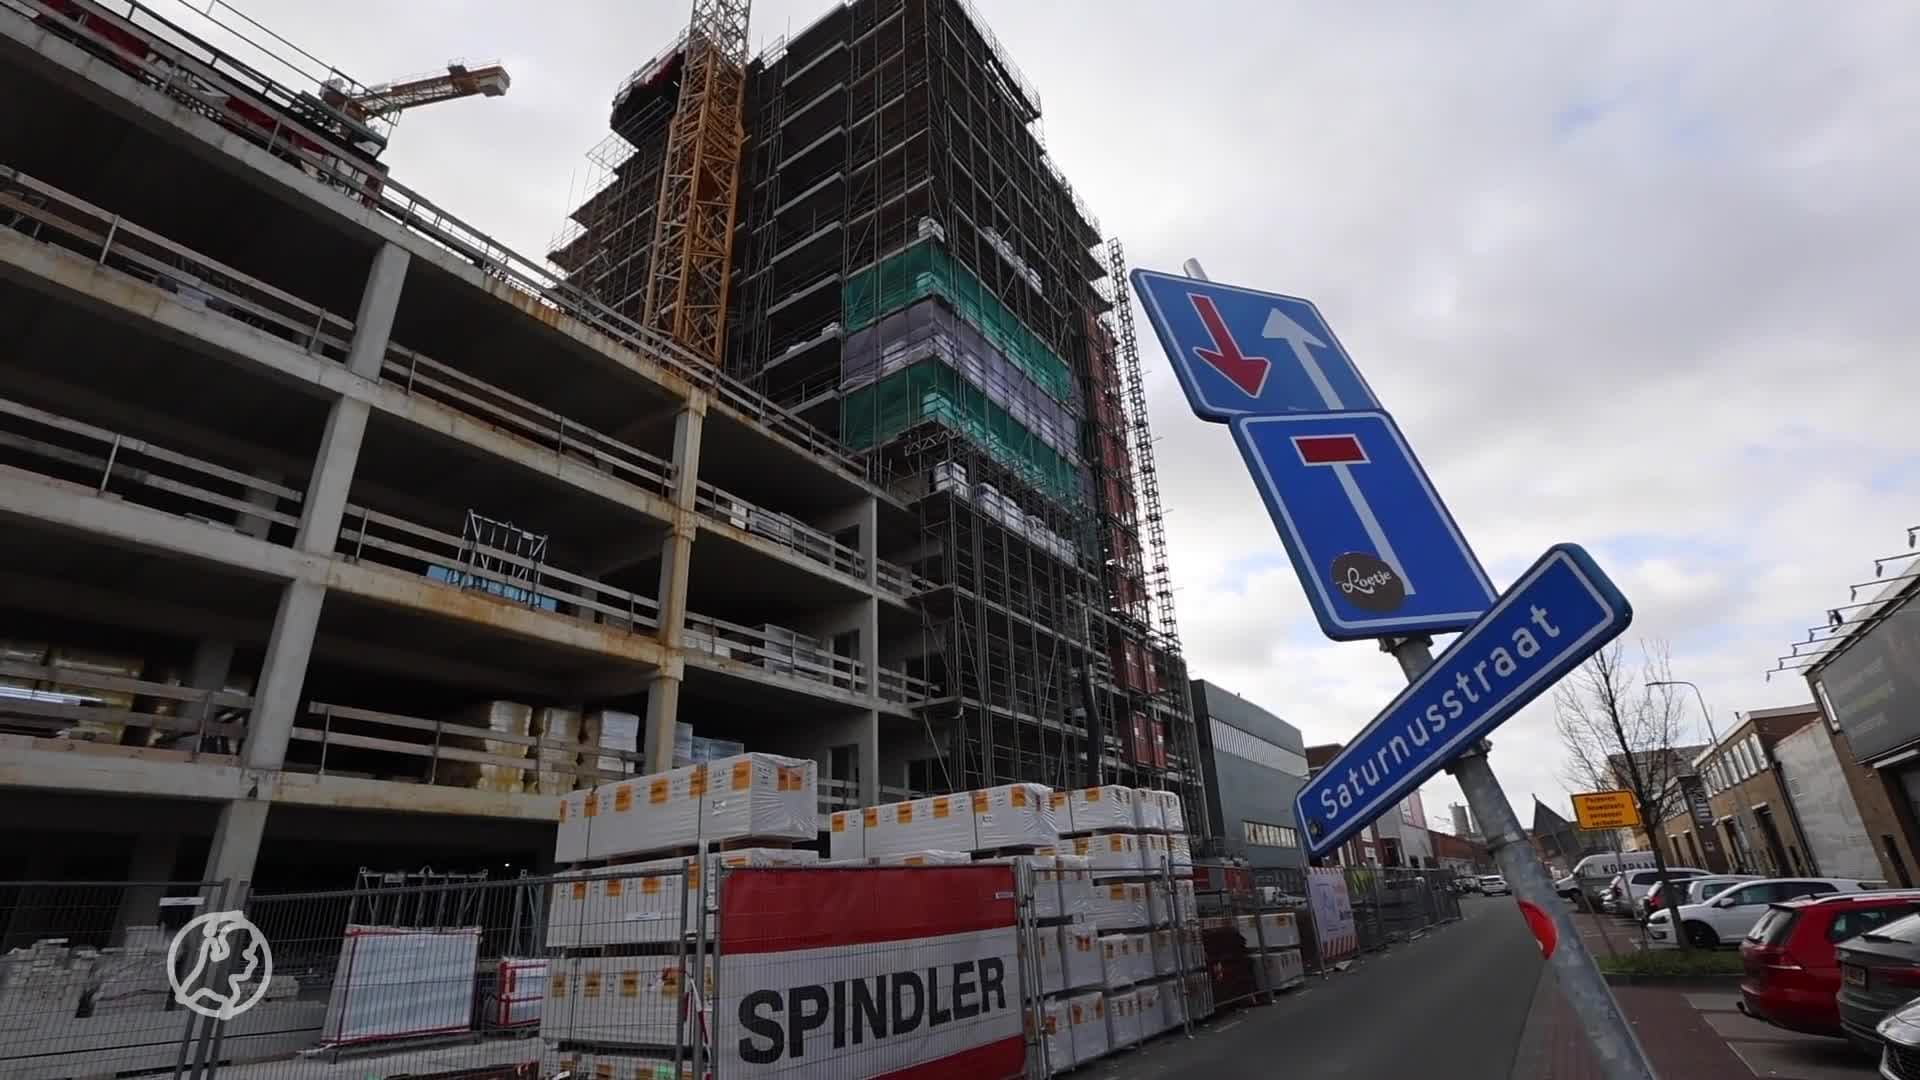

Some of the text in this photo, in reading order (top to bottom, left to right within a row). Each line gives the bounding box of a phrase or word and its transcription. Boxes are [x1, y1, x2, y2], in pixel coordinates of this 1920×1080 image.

[1336, 567, 1392, 595] Loetje
[1321, 604, 1560, 819] Saturnusstraat
[738, 957, 1007, 1064] SPINDLER
